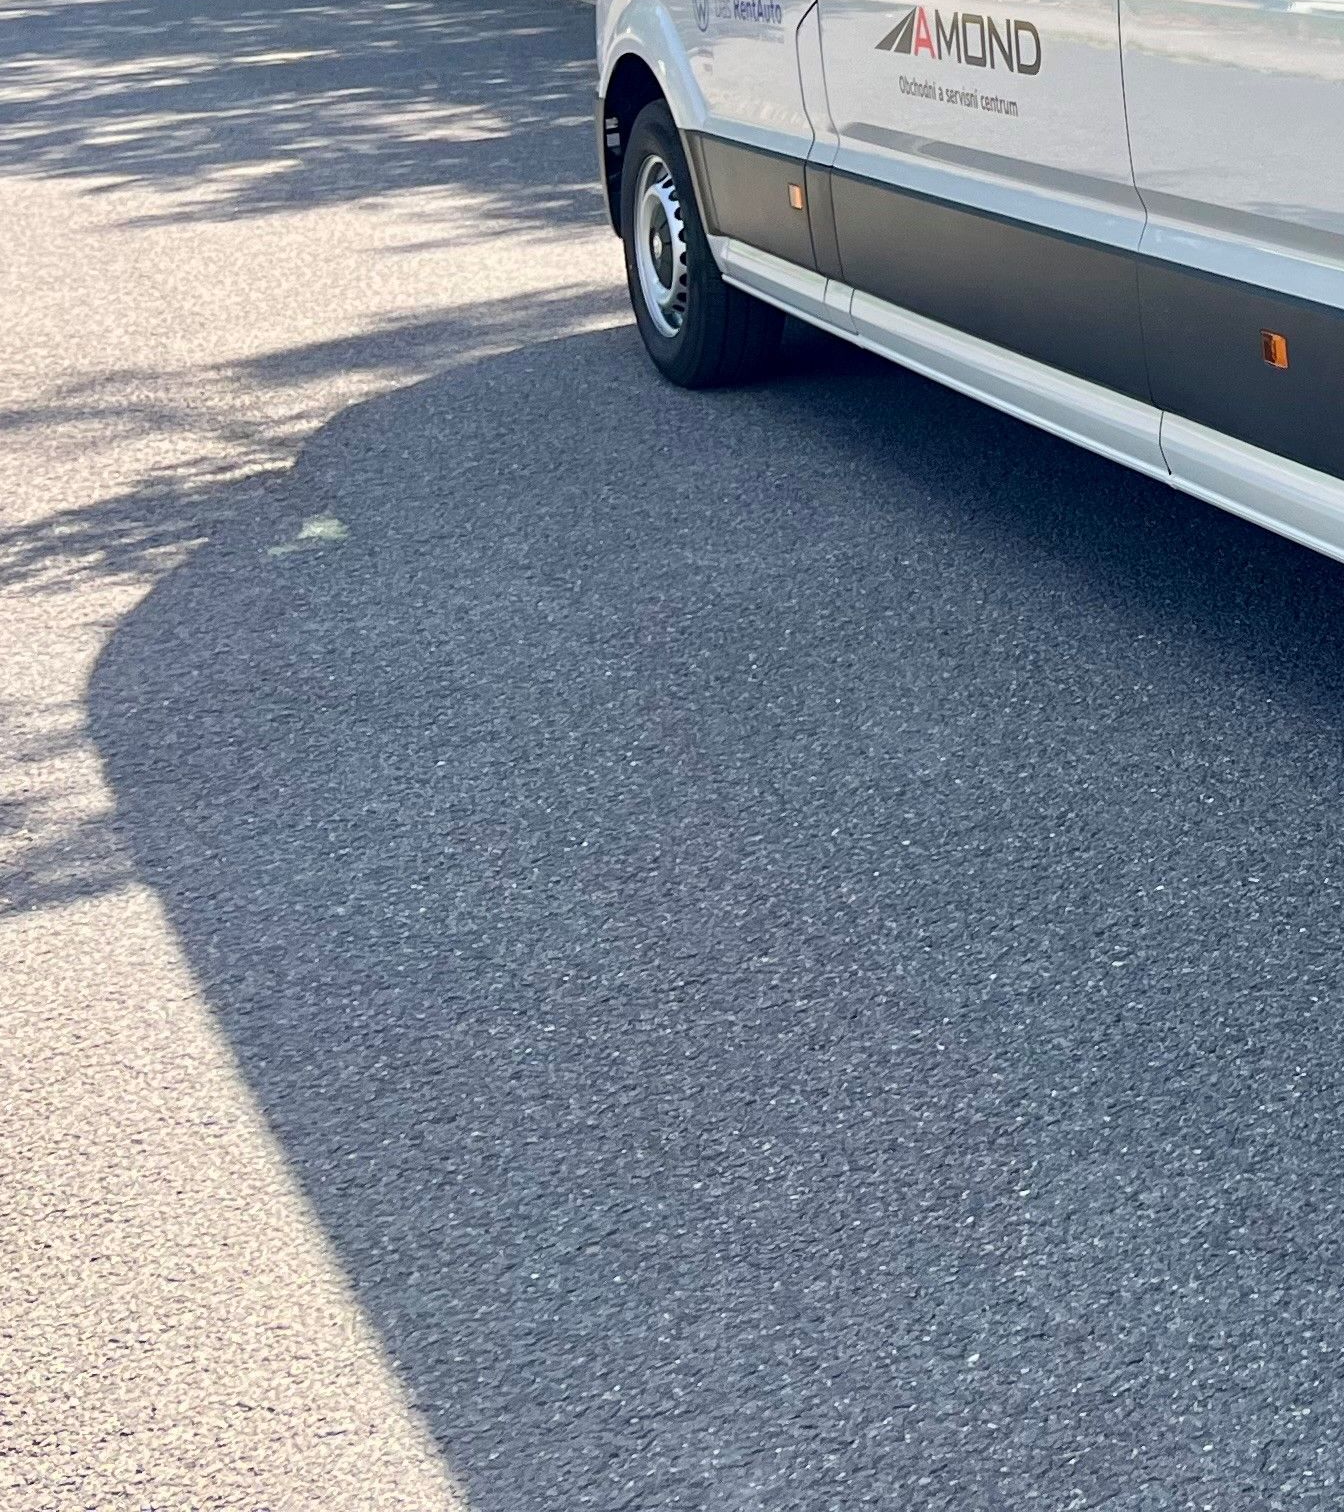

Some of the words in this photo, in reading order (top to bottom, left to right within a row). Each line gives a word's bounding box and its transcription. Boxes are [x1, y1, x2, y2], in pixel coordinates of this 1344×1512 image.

[914, 6, 1042, 76] AMOND
[939, 87, 944, 101] a
[981, 96, 1019, 117] centrum
